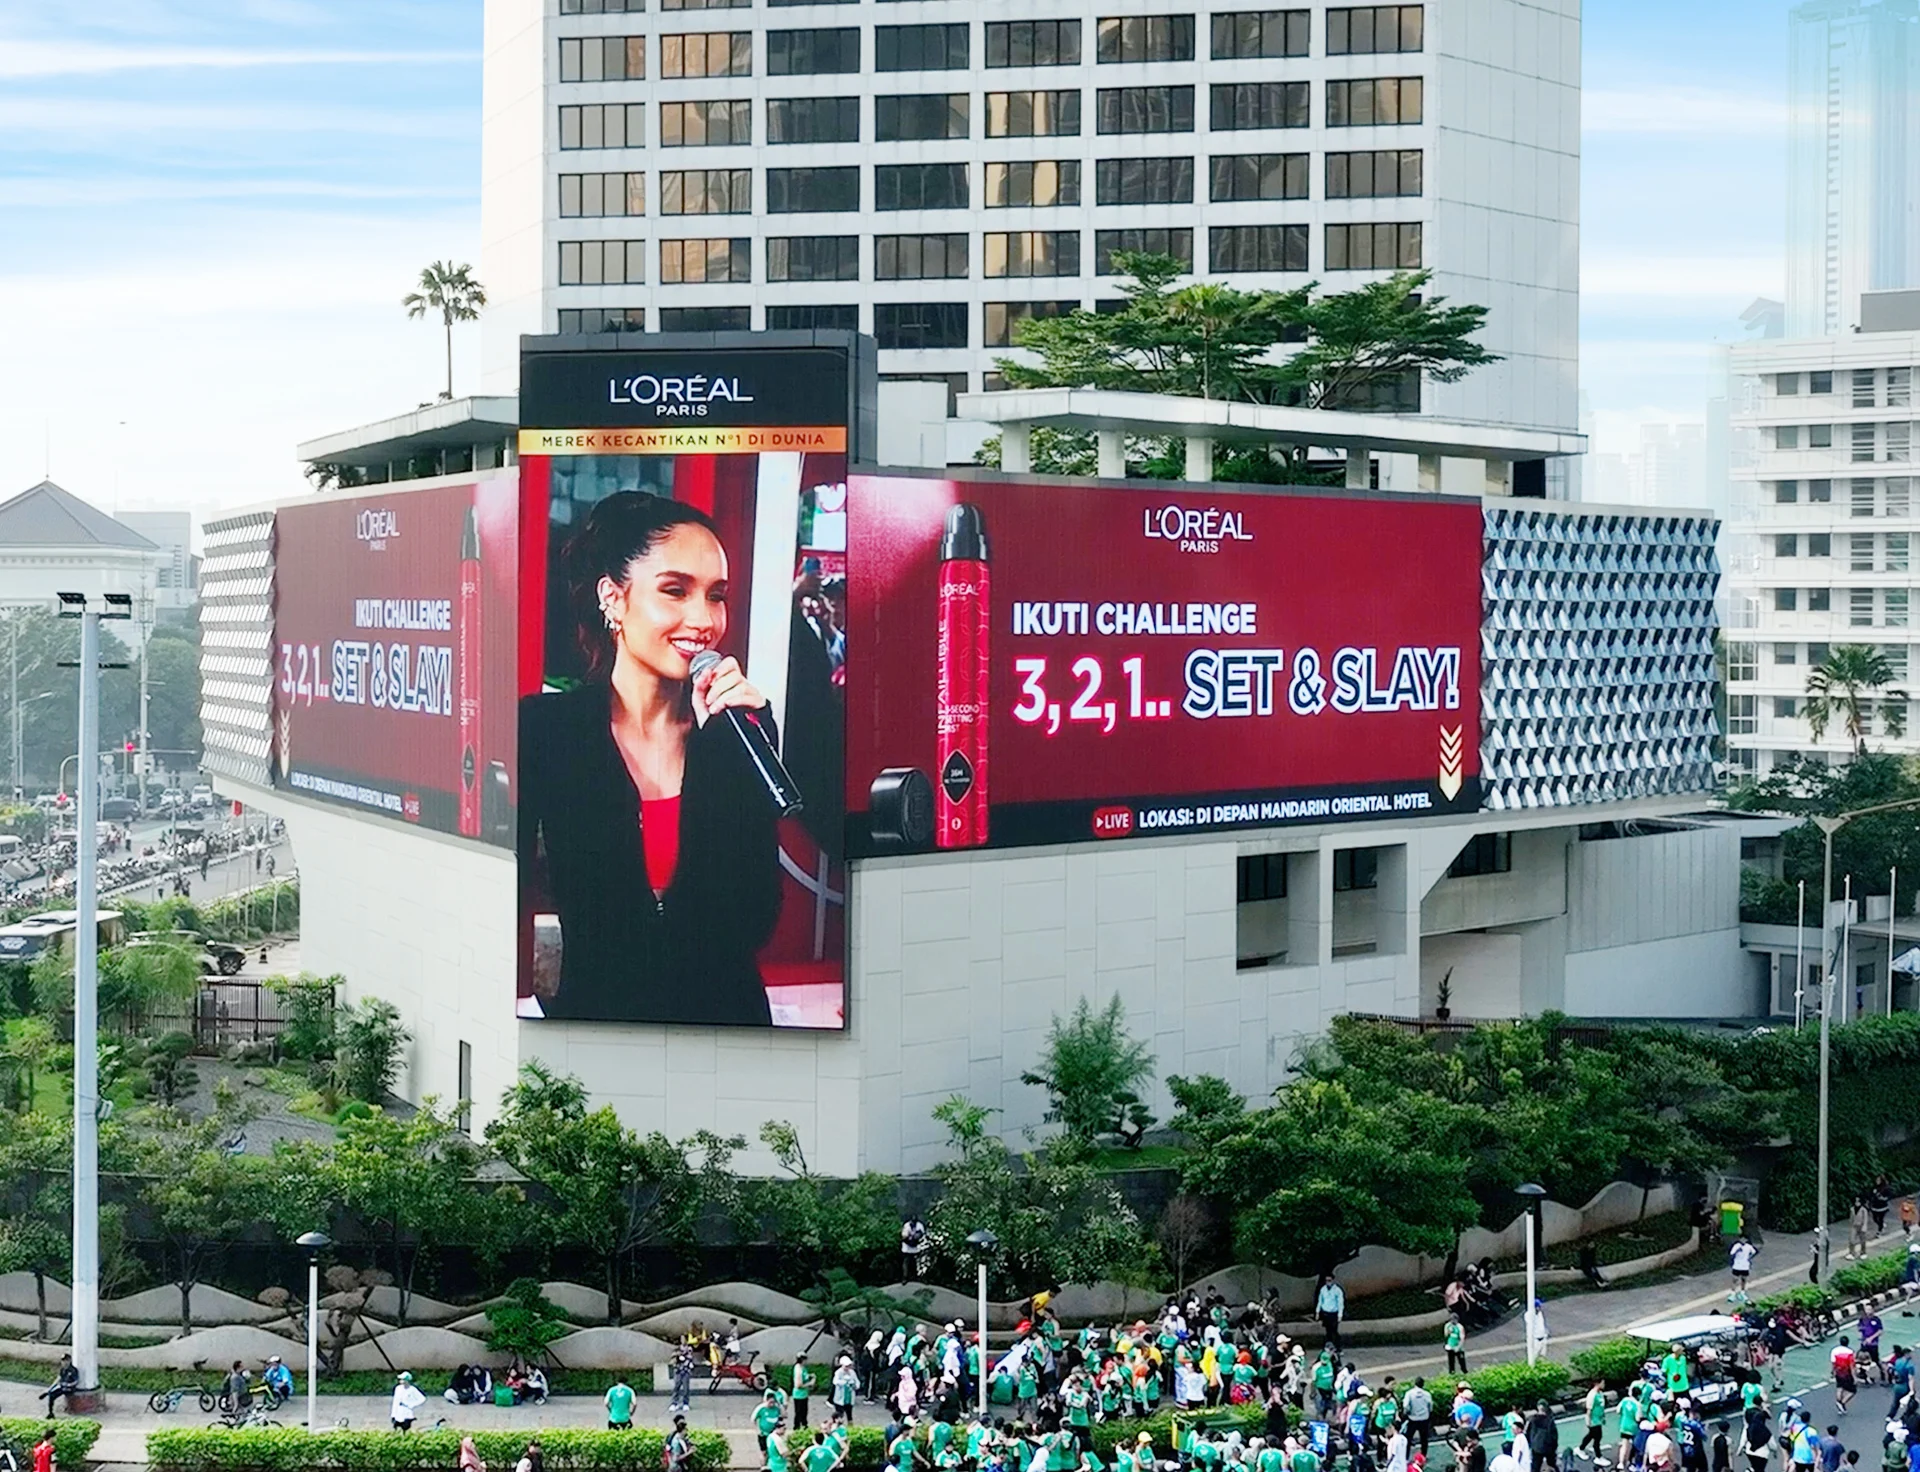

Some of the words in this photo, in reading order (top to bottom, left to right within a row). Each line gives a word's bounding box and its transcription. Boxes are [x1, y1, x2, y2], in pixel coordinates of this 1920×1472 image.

[609, 374, 754, 404] L'ORÉAL
[656, 404, 708, 416] PARIS
[542, 435, 596, 448] MEREK
[602, 434, 708, 447] KECANTIKAN
[748, 434, 765, 446] DI
[772, 433, 825, 446] DUNIA
[1144, 505, 1254, 540] L'ORÉAL
[1180, 540, 1219, 553] PARIS
[355, 599, 383, 628] IKUTI
[384, 599, 451, 631] CHALLENGE
[1012, 601, 1089, 636] IKUTI
[1095, 601, 1258, 636] CHALLENGE
[331, 638, 370, 705] SET
[370, 641, 388, 709] &
[388, 642, 453, 717] SLAY!
[1182, 648, 1284, 720] SET
[1289, 646, 1327, 716] &
[1330, 646, 1461, 715] SLAY!
[1104, 812, 1130, 829] LIVE
[1139, 807, 1194, 828] LOKASI:
[1196, 806, 1212, 824] DI
[1213, 803, 1259, 823] DEPAN
[1261, 799, 1330, 820] MANDARIN
[1331, 794, 1392, 815] ORIENTAL
[1394, 791, 1433, 810] HOTEL
